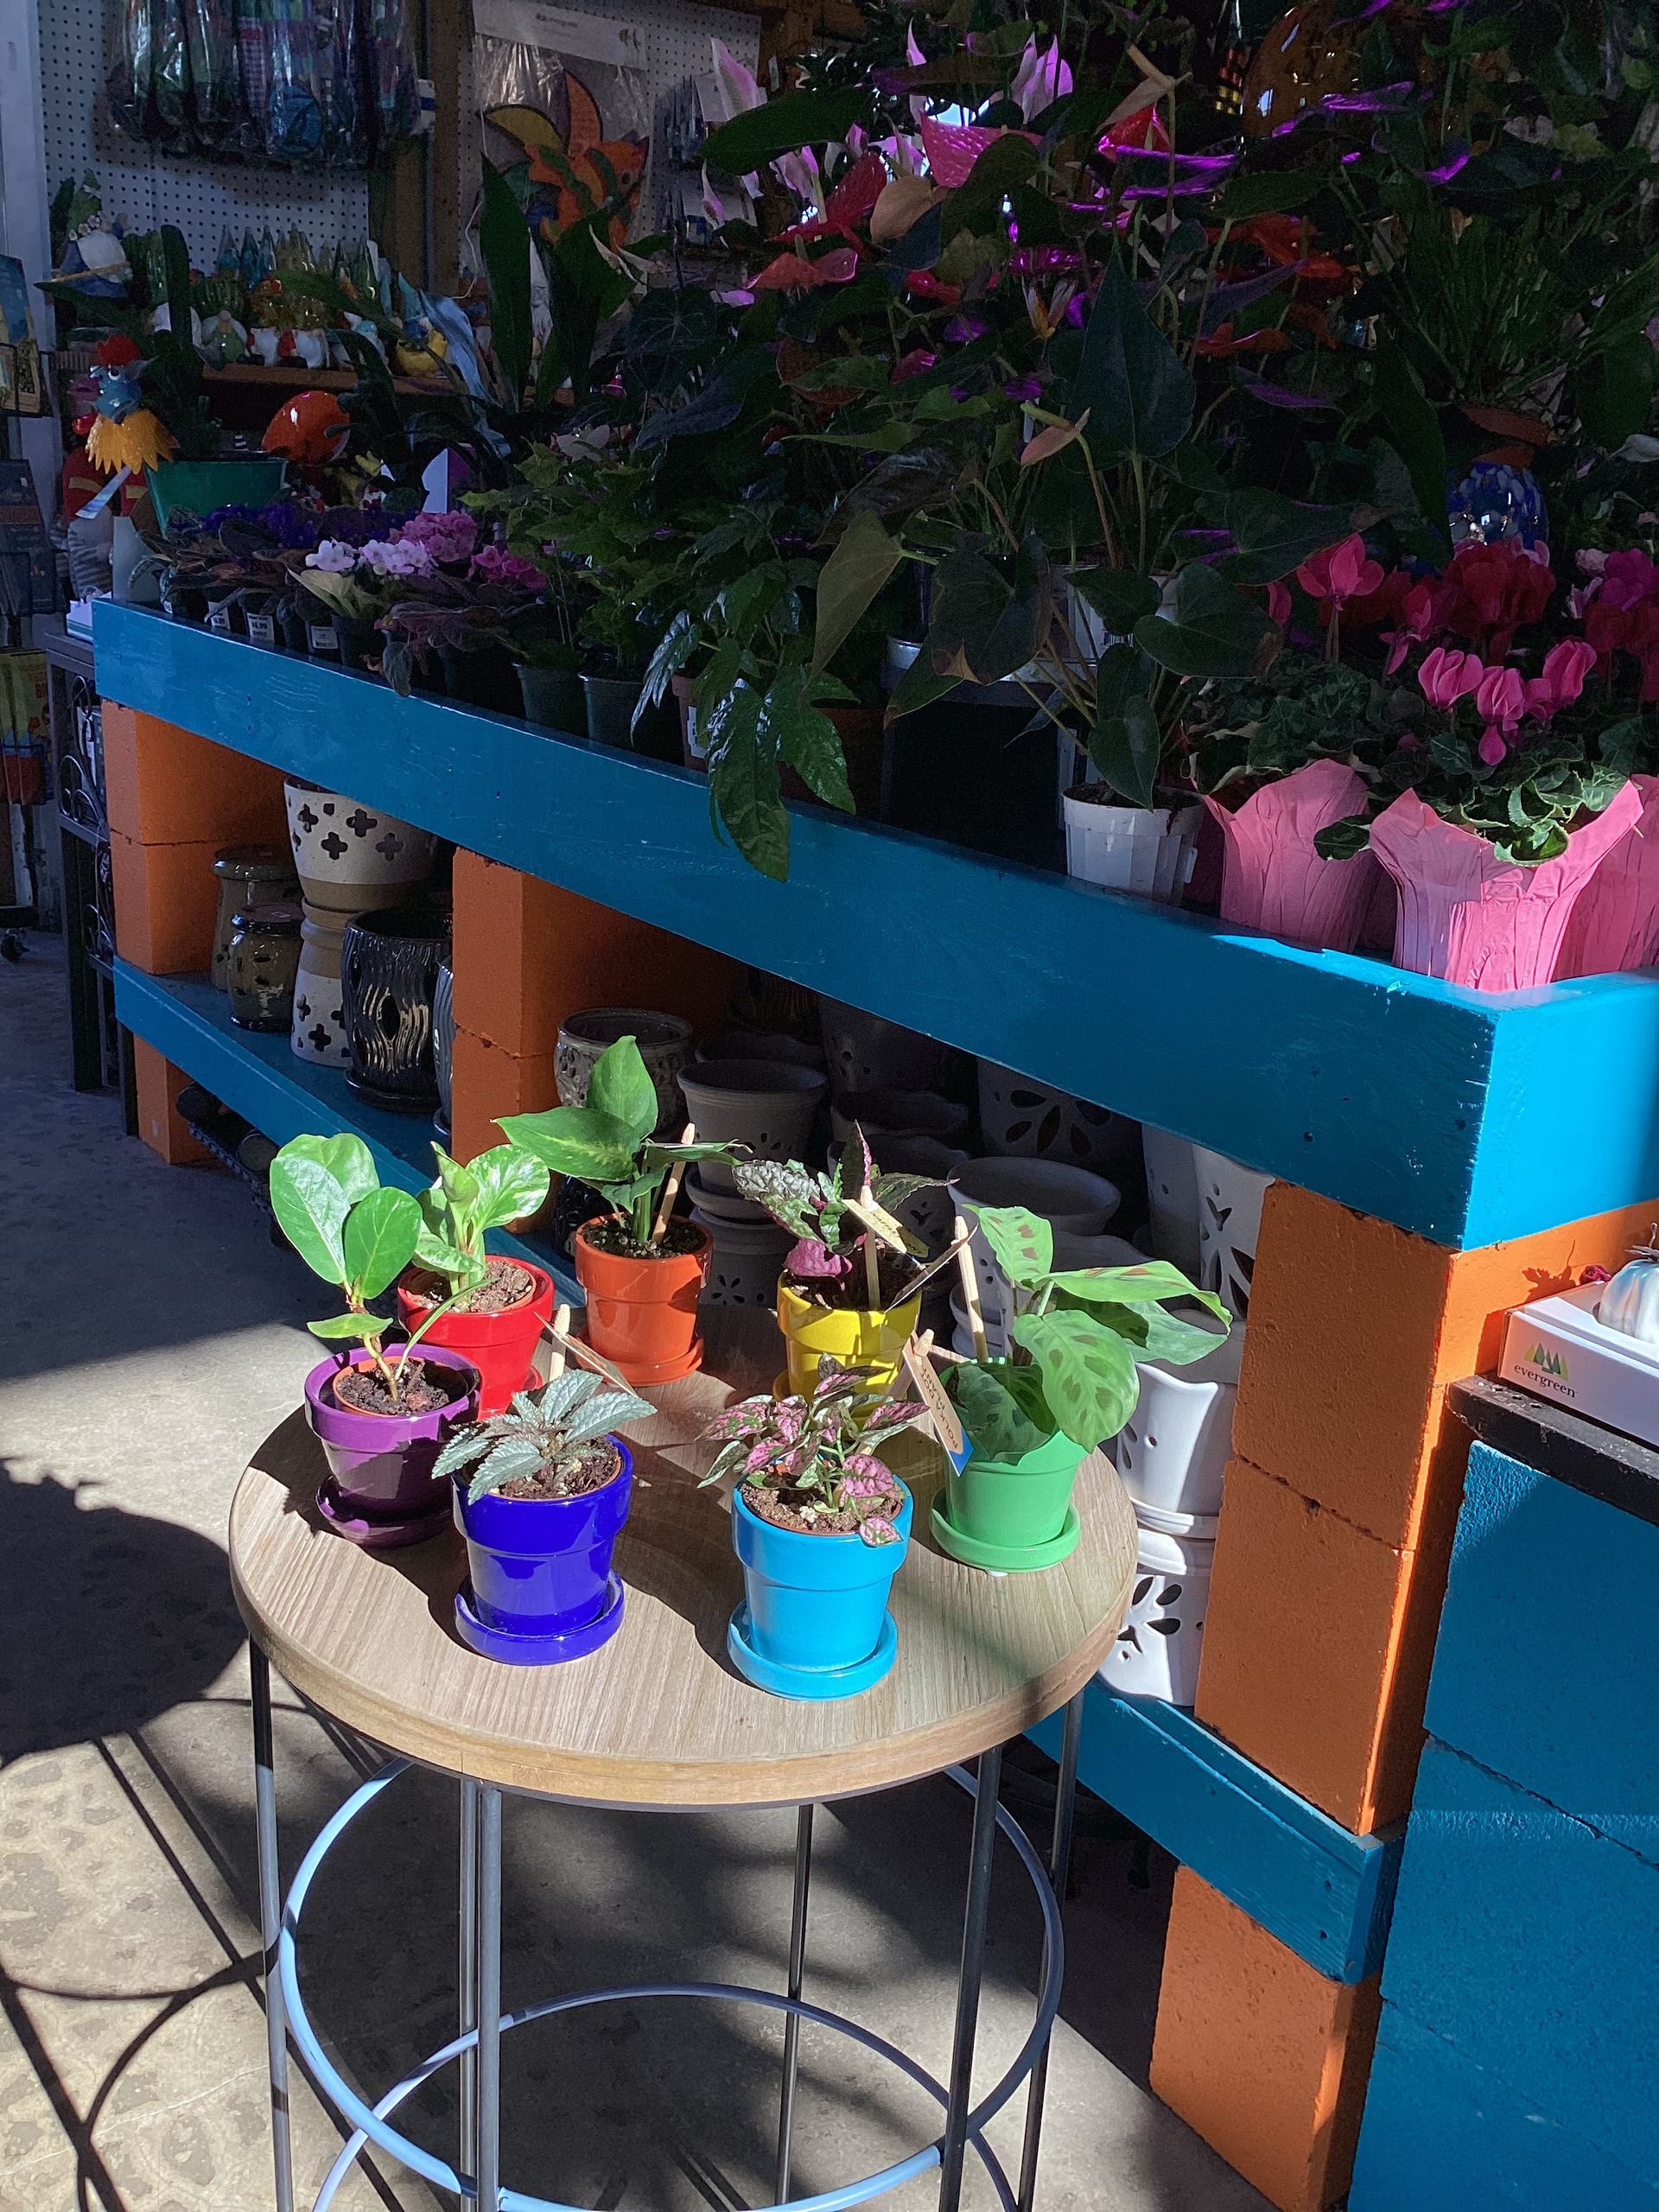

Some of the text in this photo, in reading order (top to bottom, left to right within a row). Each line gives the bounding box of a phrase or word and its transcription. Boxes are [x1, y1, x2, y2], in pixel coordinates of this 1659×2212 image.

[922, 1367, 944, 1410] PLANT
[1514, 1364, 1575, 1397] evergreen
[920, 1372, 957, 1448] POLKA DOT
